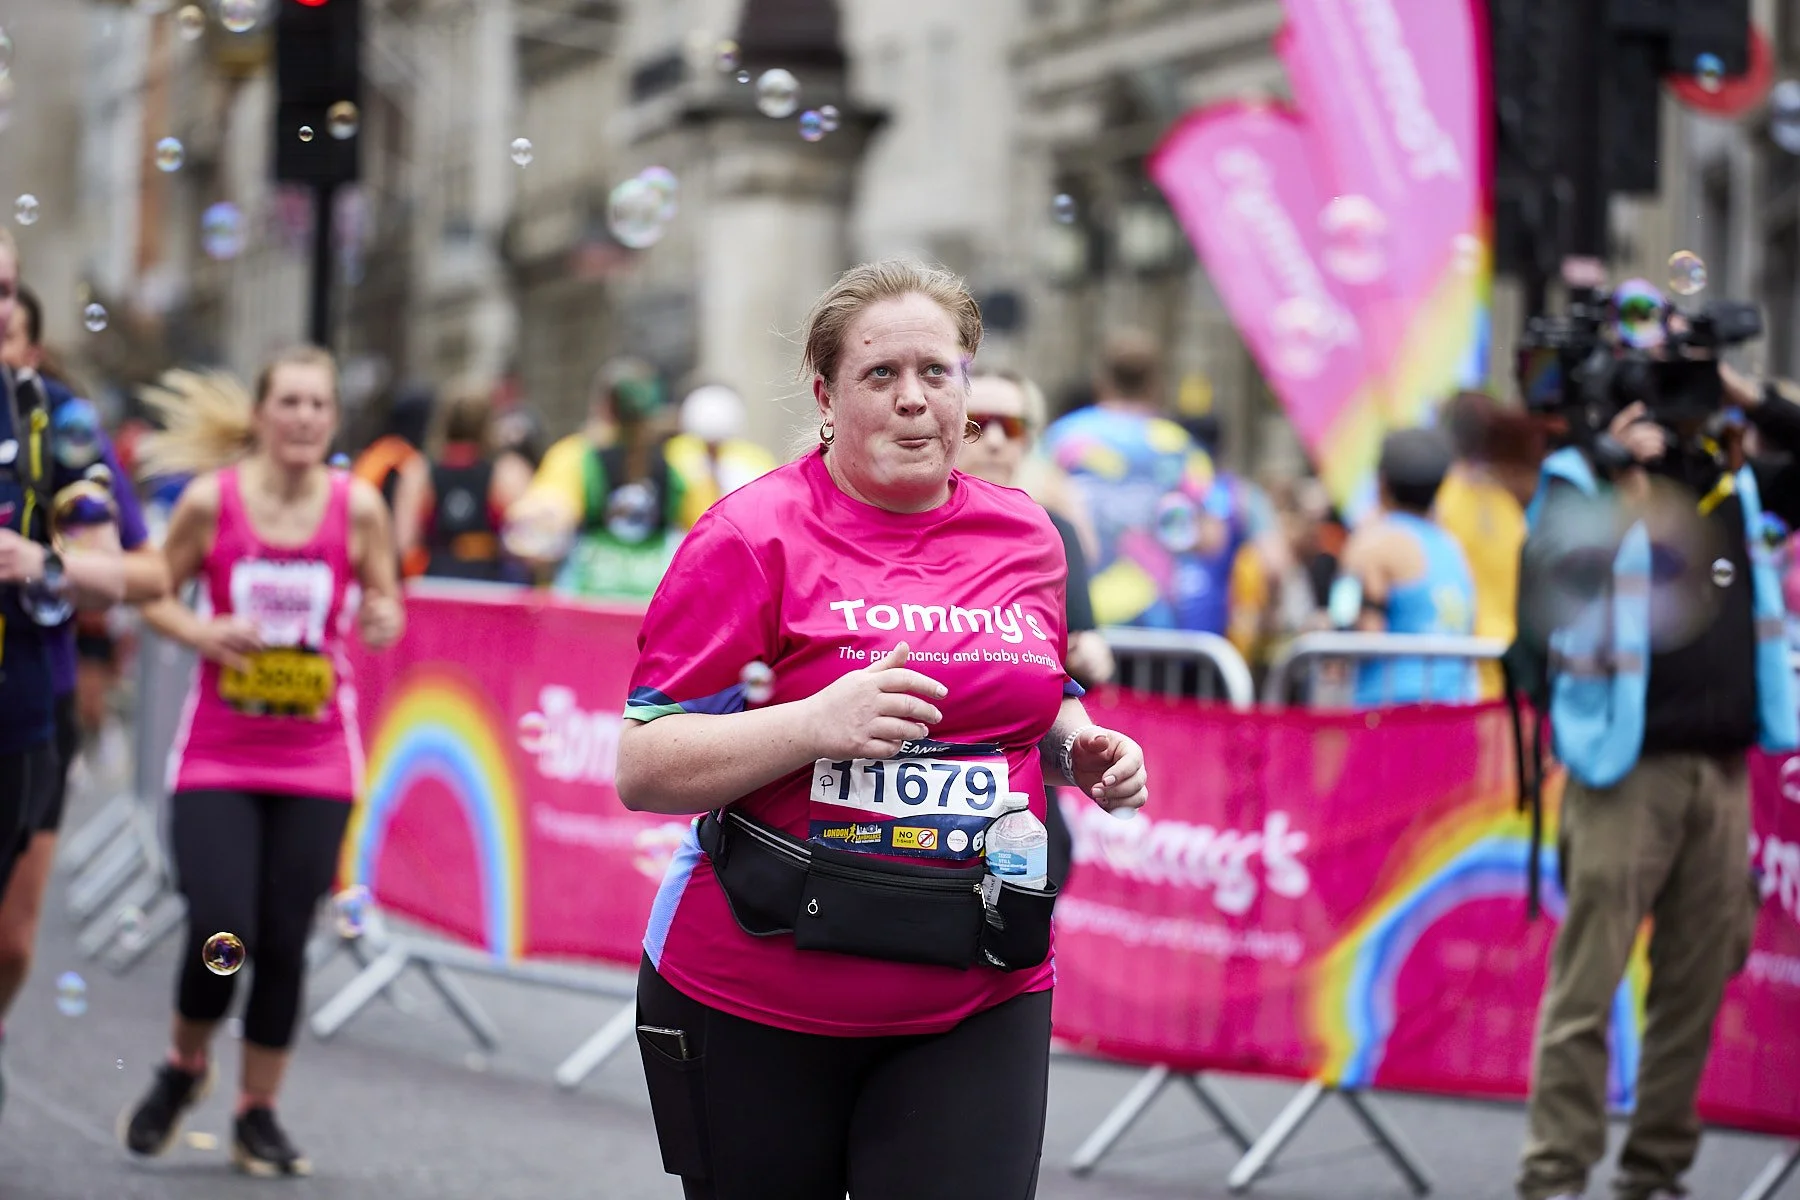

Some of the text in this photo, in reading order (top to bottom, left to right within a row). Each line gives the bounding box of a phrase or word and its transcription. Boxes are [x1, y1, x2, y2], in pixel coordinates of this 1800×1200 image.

[829, 598, 1047, 644] Tommy's
[838, 646, 866, 660] The
[952, 649, 980, 662] and
[982, 648, 1019, 664] baby
[1022, 650, 1057, 671] charity
[831, 760, 997, 811] 11679
[823, 828, 850, 838] LONDON
[898, 831, 913, 839] NO
